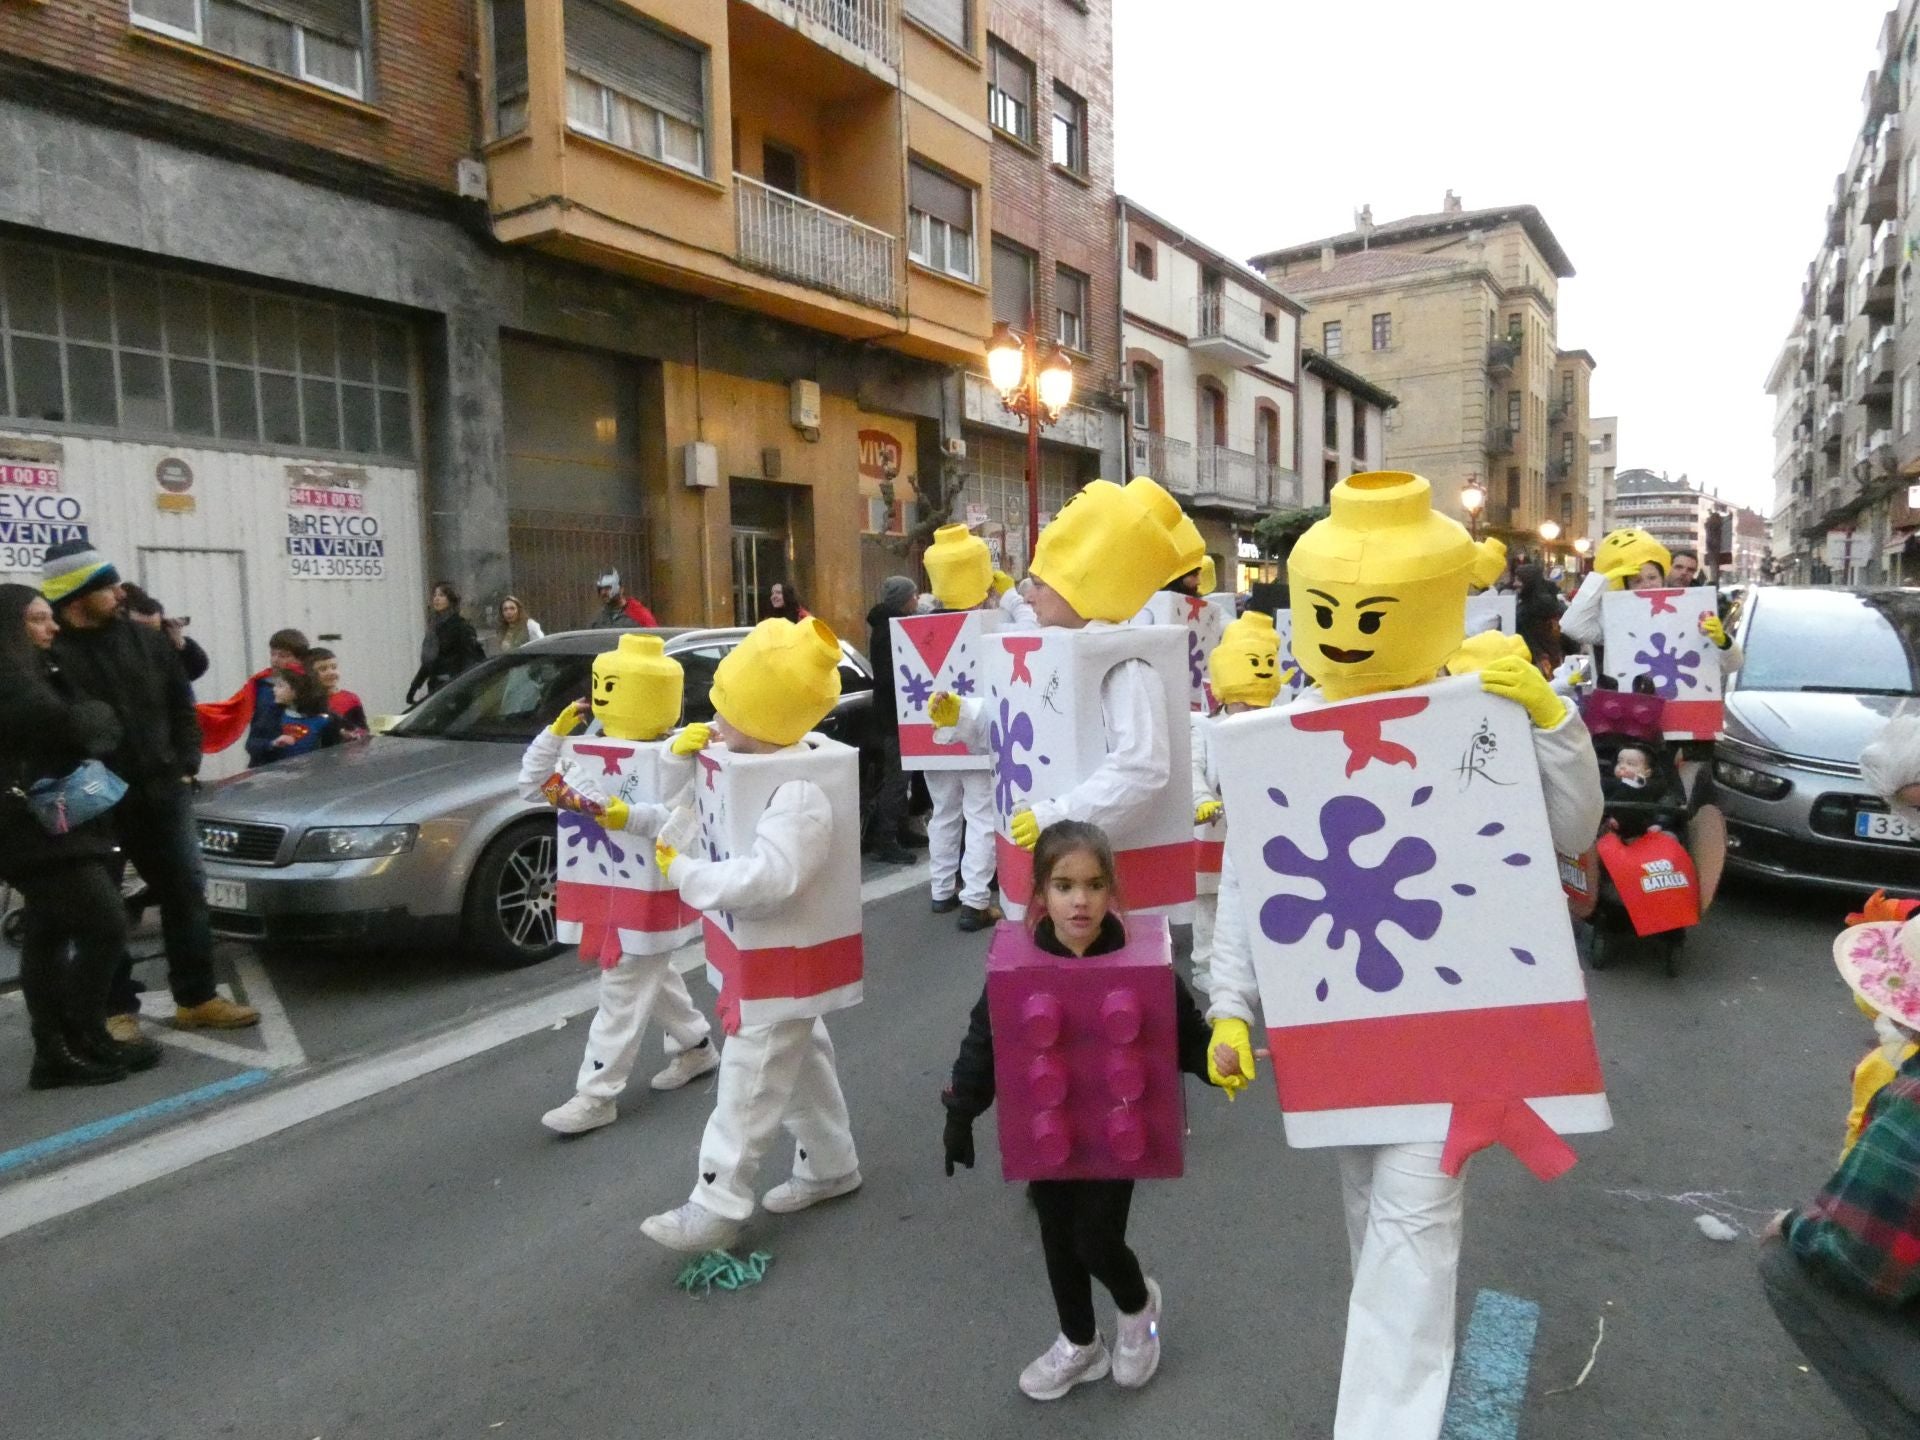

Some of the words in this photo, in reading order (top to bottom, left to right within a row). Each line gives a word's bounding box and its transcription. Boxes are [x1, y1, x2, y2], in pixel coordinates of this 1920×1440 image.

[13, 467, 34, 484] 00
[38, 470, 58, 487] 93
[315, 490, 328, 505] 31
[331, 492, 346, 507] 00
[348, 494, 363, 508] 93
[0, 522, 82, 544] VENTA
[304, 514, 378, 537] REYCO
[291, 538, 315, 555] EN
[320, 539, 382, 557] VENTA
[1643, 873, 1689, 890] BATALLA
